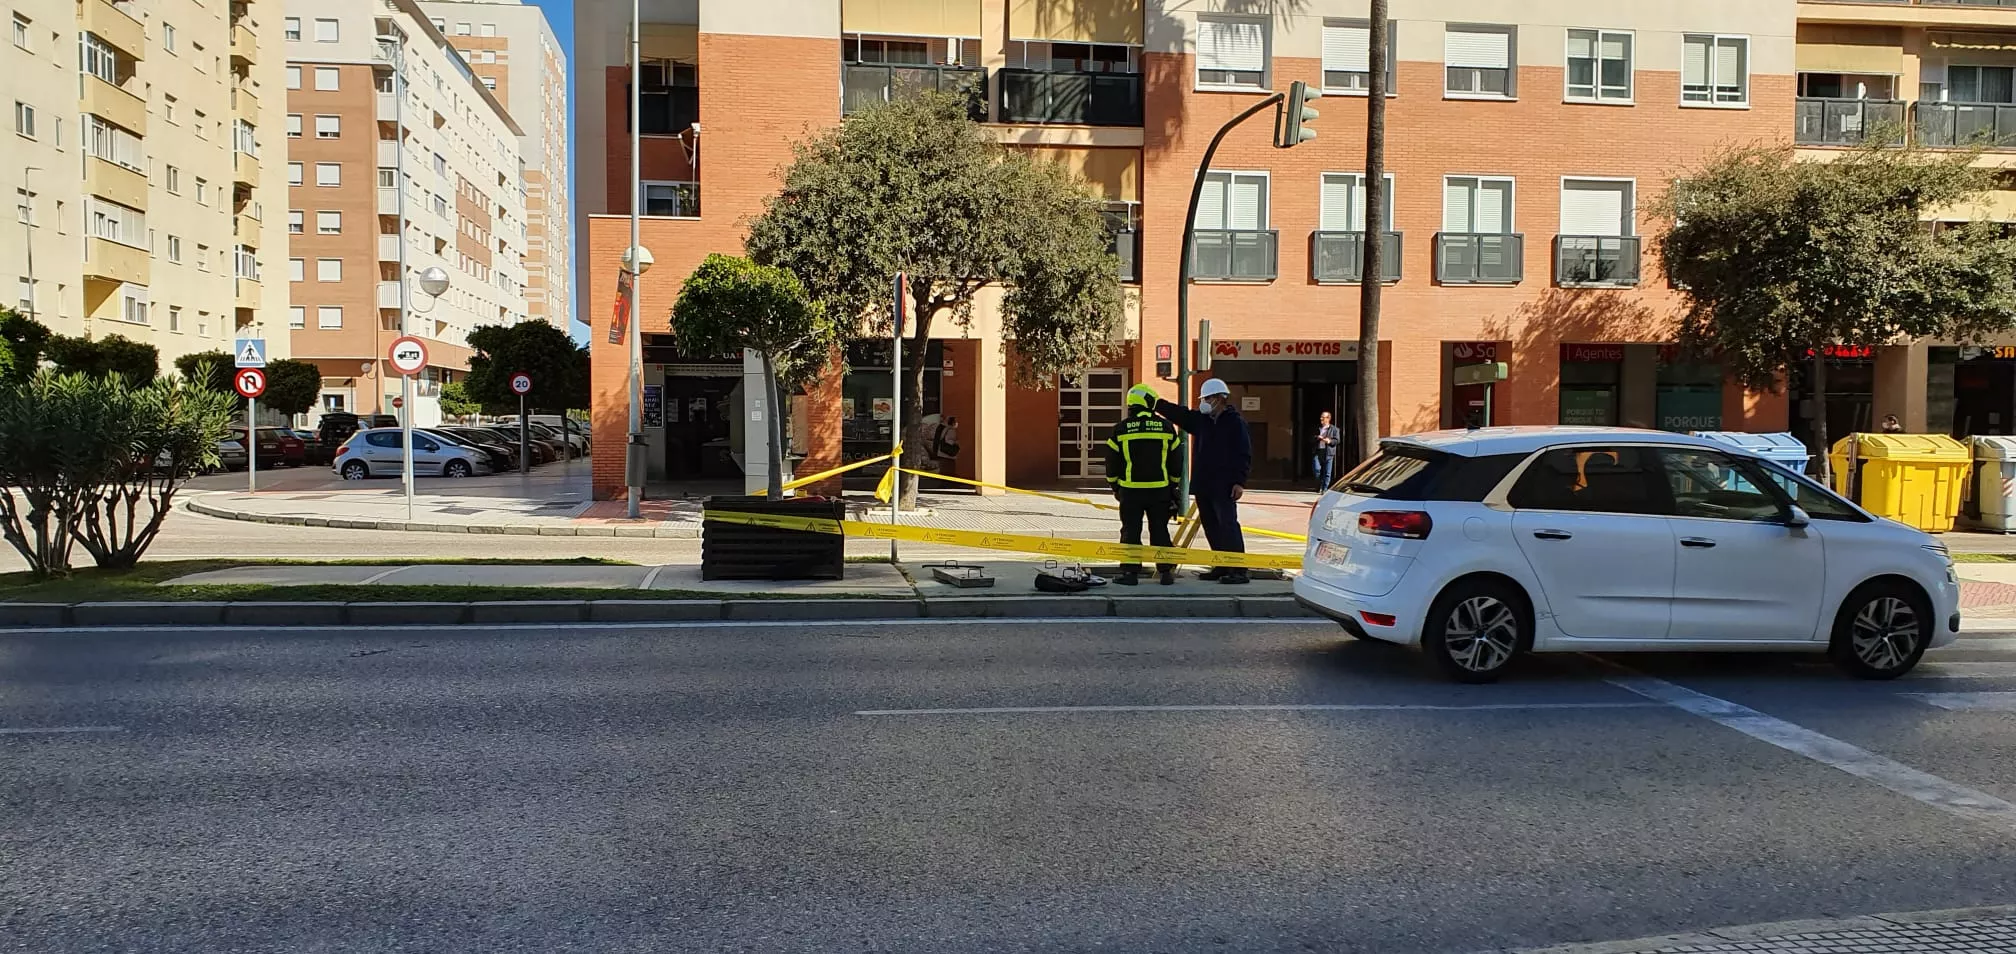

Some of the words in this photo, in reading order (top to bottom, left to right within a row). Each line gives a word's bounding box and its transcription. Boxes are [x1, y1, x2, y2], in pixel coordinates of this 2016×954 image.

[1253, 342, 1281, 355] LAS
[1575, 347, 1622, 361] Agentes
[515, 380, 528, 388] 20
[1664, 416, 1715, 428] PORQUE
